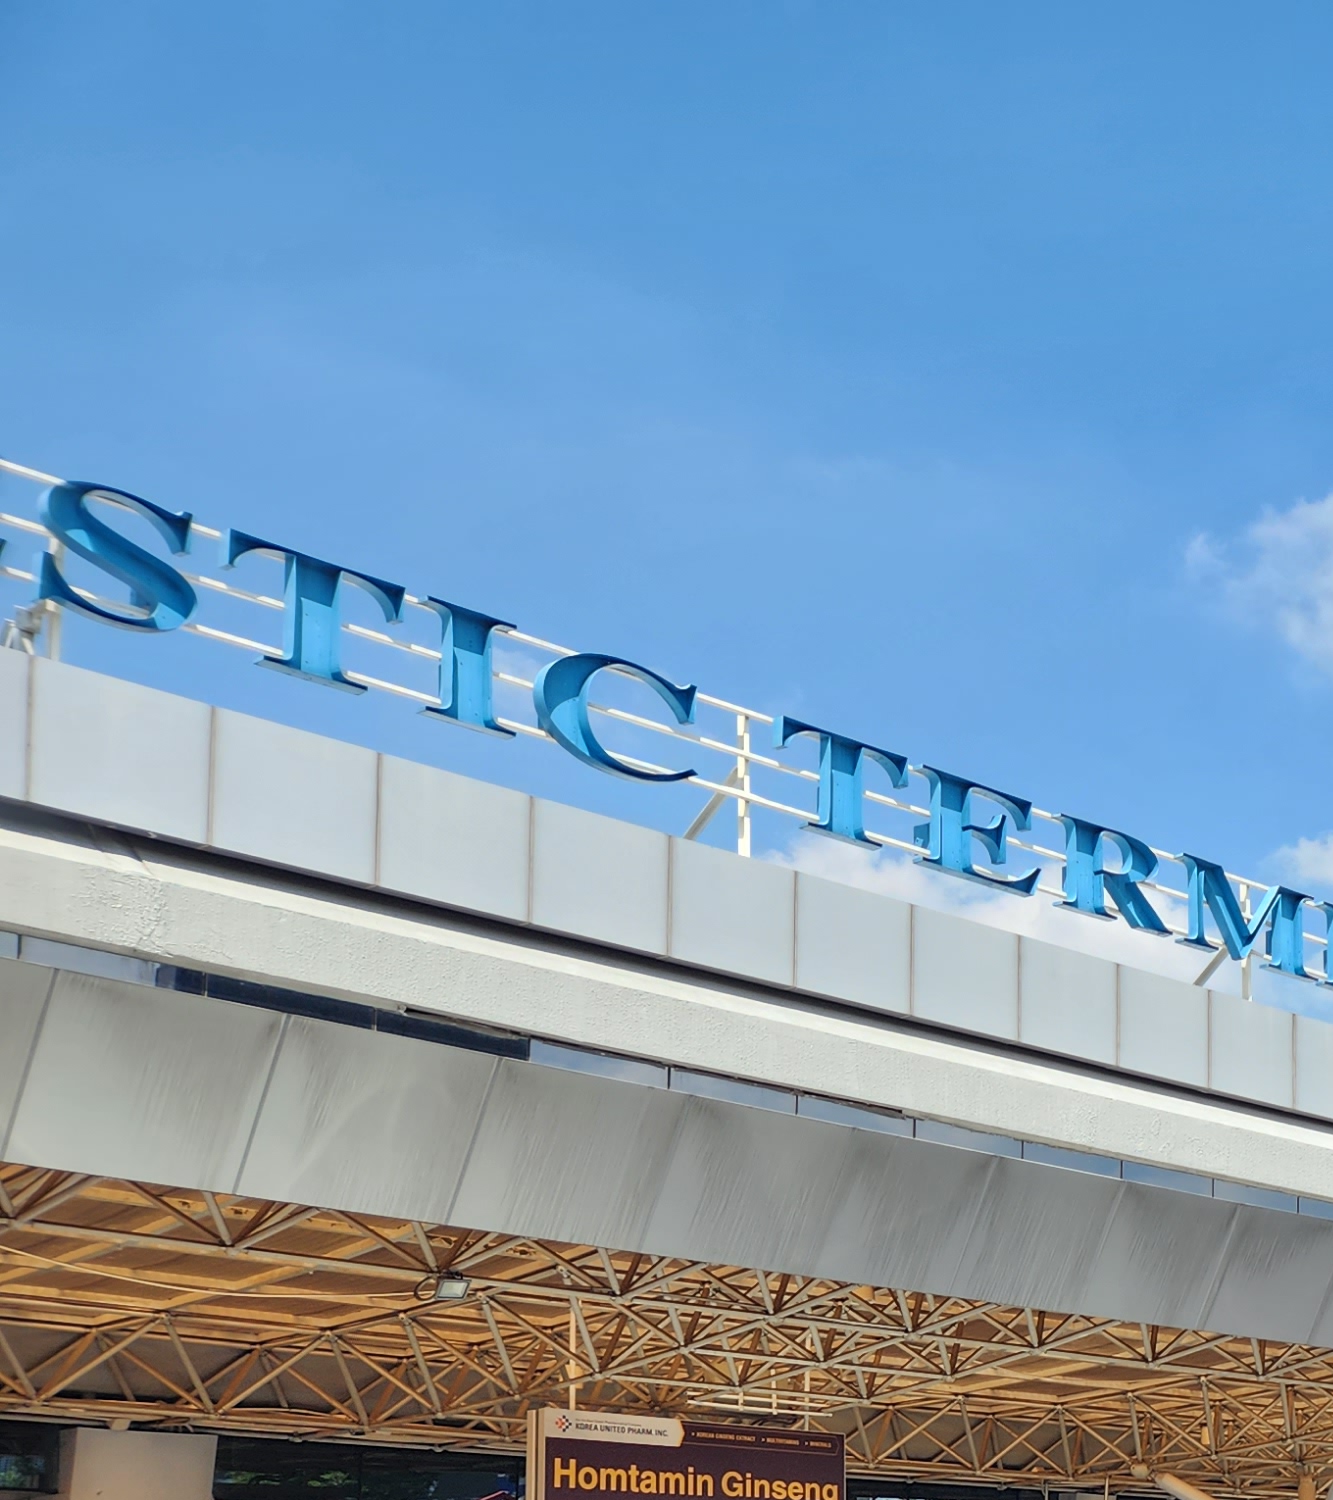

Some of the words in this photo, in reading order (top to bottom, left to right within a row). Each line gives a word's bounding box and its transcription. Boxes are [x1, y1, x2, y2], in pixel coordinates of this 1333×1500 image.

[0, 480, 698, 783] STIC
[575, 1423, 599, 1431] KOREA
[600, 1425, 626, 1434] UNITED
[655, 1429, 669, 1437] INC.
[553, 1457, 714, 1496] Homtamin
